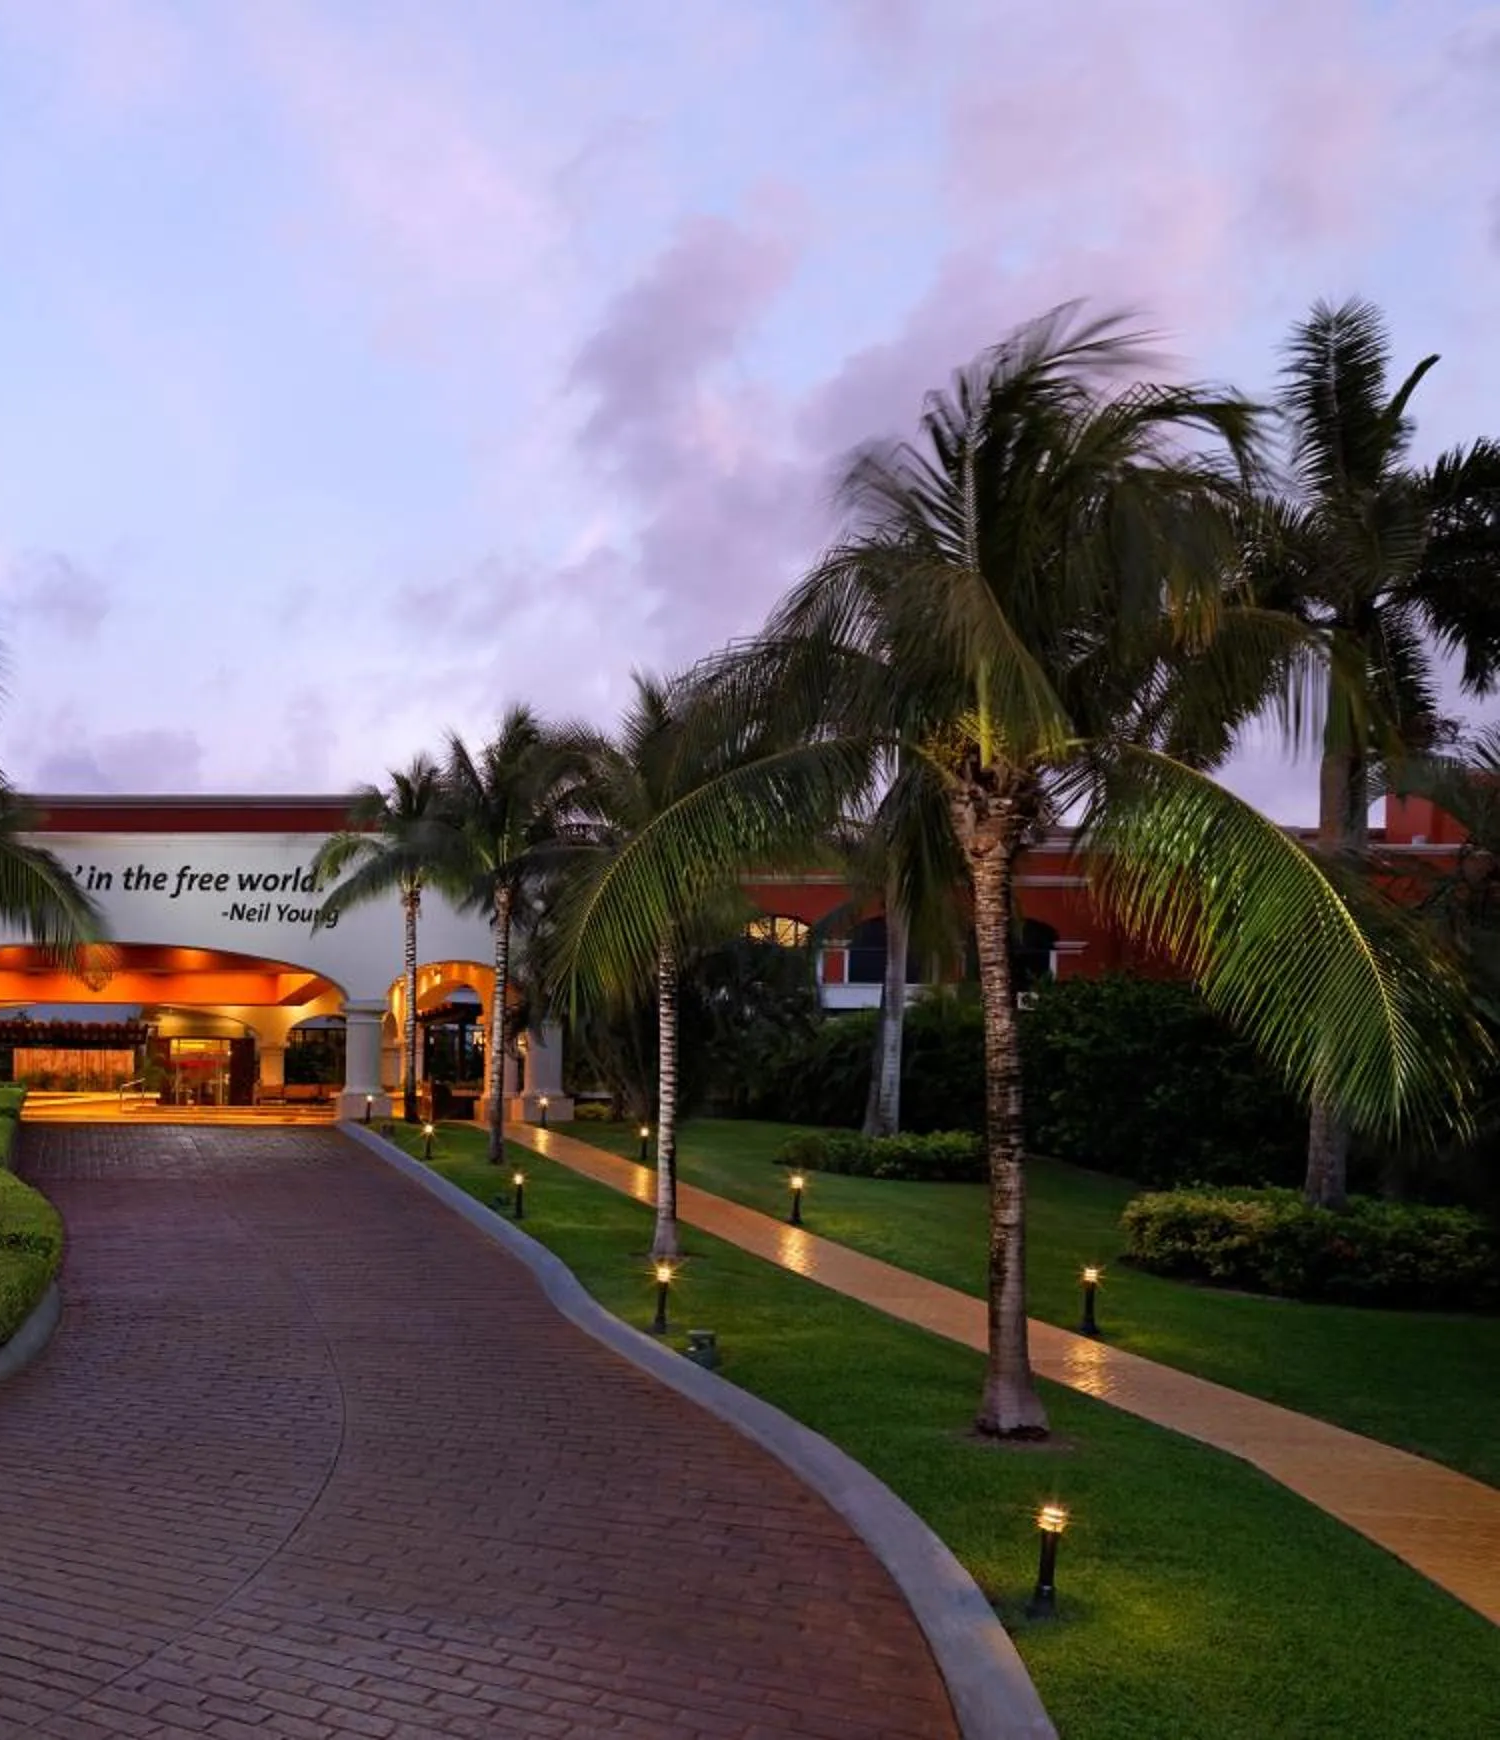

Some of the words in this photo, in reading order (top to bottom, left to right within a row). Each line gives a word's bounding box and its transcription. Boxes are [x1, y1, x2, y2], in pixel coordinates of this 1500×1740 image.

[123, 864, 167, 891] the
[170, 865, 230, 898] free
[221, 902, 271, 922] -Neil
